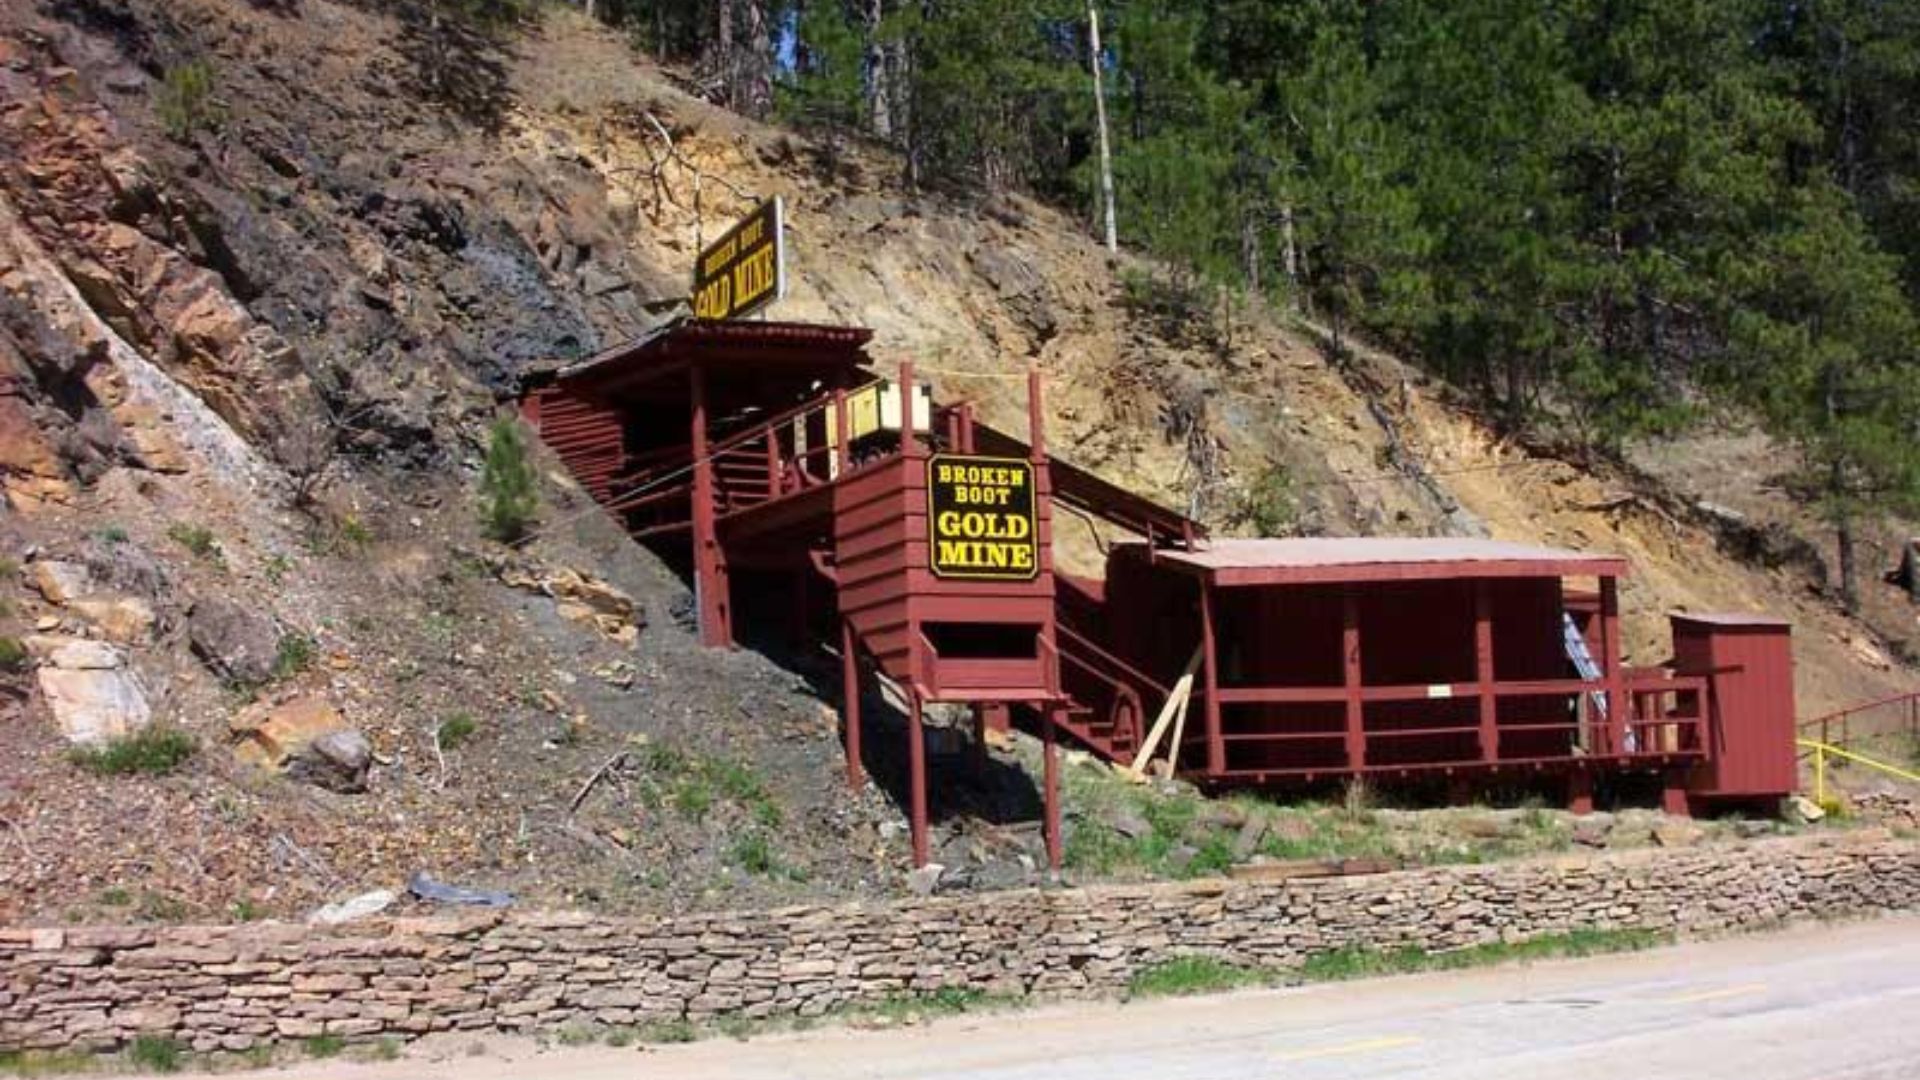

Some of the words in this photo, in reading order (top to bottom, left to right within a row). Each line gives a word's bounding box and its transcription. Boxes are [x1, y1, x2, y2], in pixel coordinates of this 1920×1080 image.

[938, 464, 1024, 486] BROKEN
[954, 484, 1010, 505] BOOT
[938, 511, 1029, 539] GOLD
[938, 540, 1032, 568] MINE
